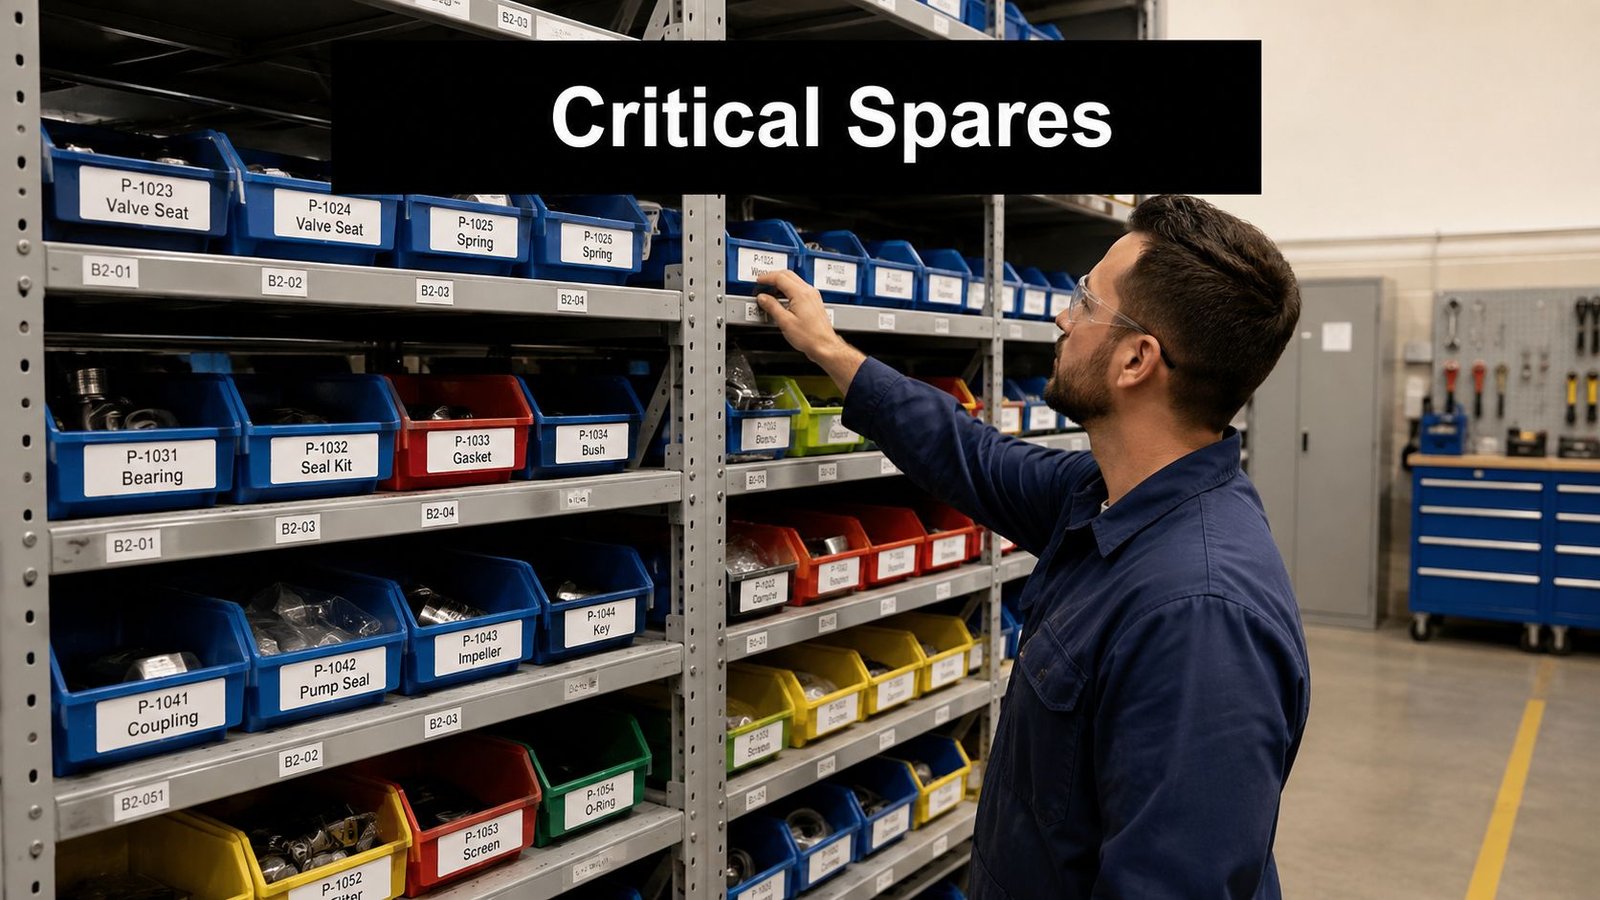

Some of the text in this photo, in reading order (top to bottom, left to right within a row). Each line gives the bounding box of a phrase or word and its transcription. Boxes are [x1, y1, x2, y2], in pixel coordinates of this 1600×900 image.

[121, 178, 173, 198] P-1023
[106, 197, 189, 221] Valve Seat
[309, 199, 351, 216] P-1024
[296, 216, 364, 237] Valve Seat
[458, 216, 494, 232] P-1025
[457, 233, 494, 252] Spring
[583, 246, 613, 262] Spring
[91, 262, 131, 279] B2-01
[268, 275, 302, 289] B2-02
[456, 434, 490, 448] P-1033
[579, 428, 608, 441] P-1034
[127, 448, 177, 465] P-1031
[306, 441, 348, 455] P-1032
[582, 444, 605, 456] Bush
[301, 458, 352, 475] Seal Kit
[453, 451, 492, 465] Gasket
[122, 468, 183, 486] Bearing
[426, 506, 455, 520] B2-04
[282, 521, 316, 536] B2-03
[114, 537, 154, 553] B2-01
[587, 606, 616, 621] P-1044
[462, 629, 498, 647] P-1043
[593, 624, 611, 636] Key
[458, 645, 502, 665] Impeller
[314, 658, 357, 678] P-1042
[300, 673, 371, 700] Pump Seal
[138, 692, 189, 715] P-1041
[128, 712, 199, 737] Coupling
[429, 714, 459, 730] B2-03
[284, 749, 319, 768] B2-02
[587, 782, 615, 800] P-1054
[121, 789, 165, 811] B2-051
[585, 798, 616, 816] O-Ring
[464, 823, 500, 844] P-1053
[463, 839, 501, 861] Screen
[322, 871, 363, 897] P-1052
